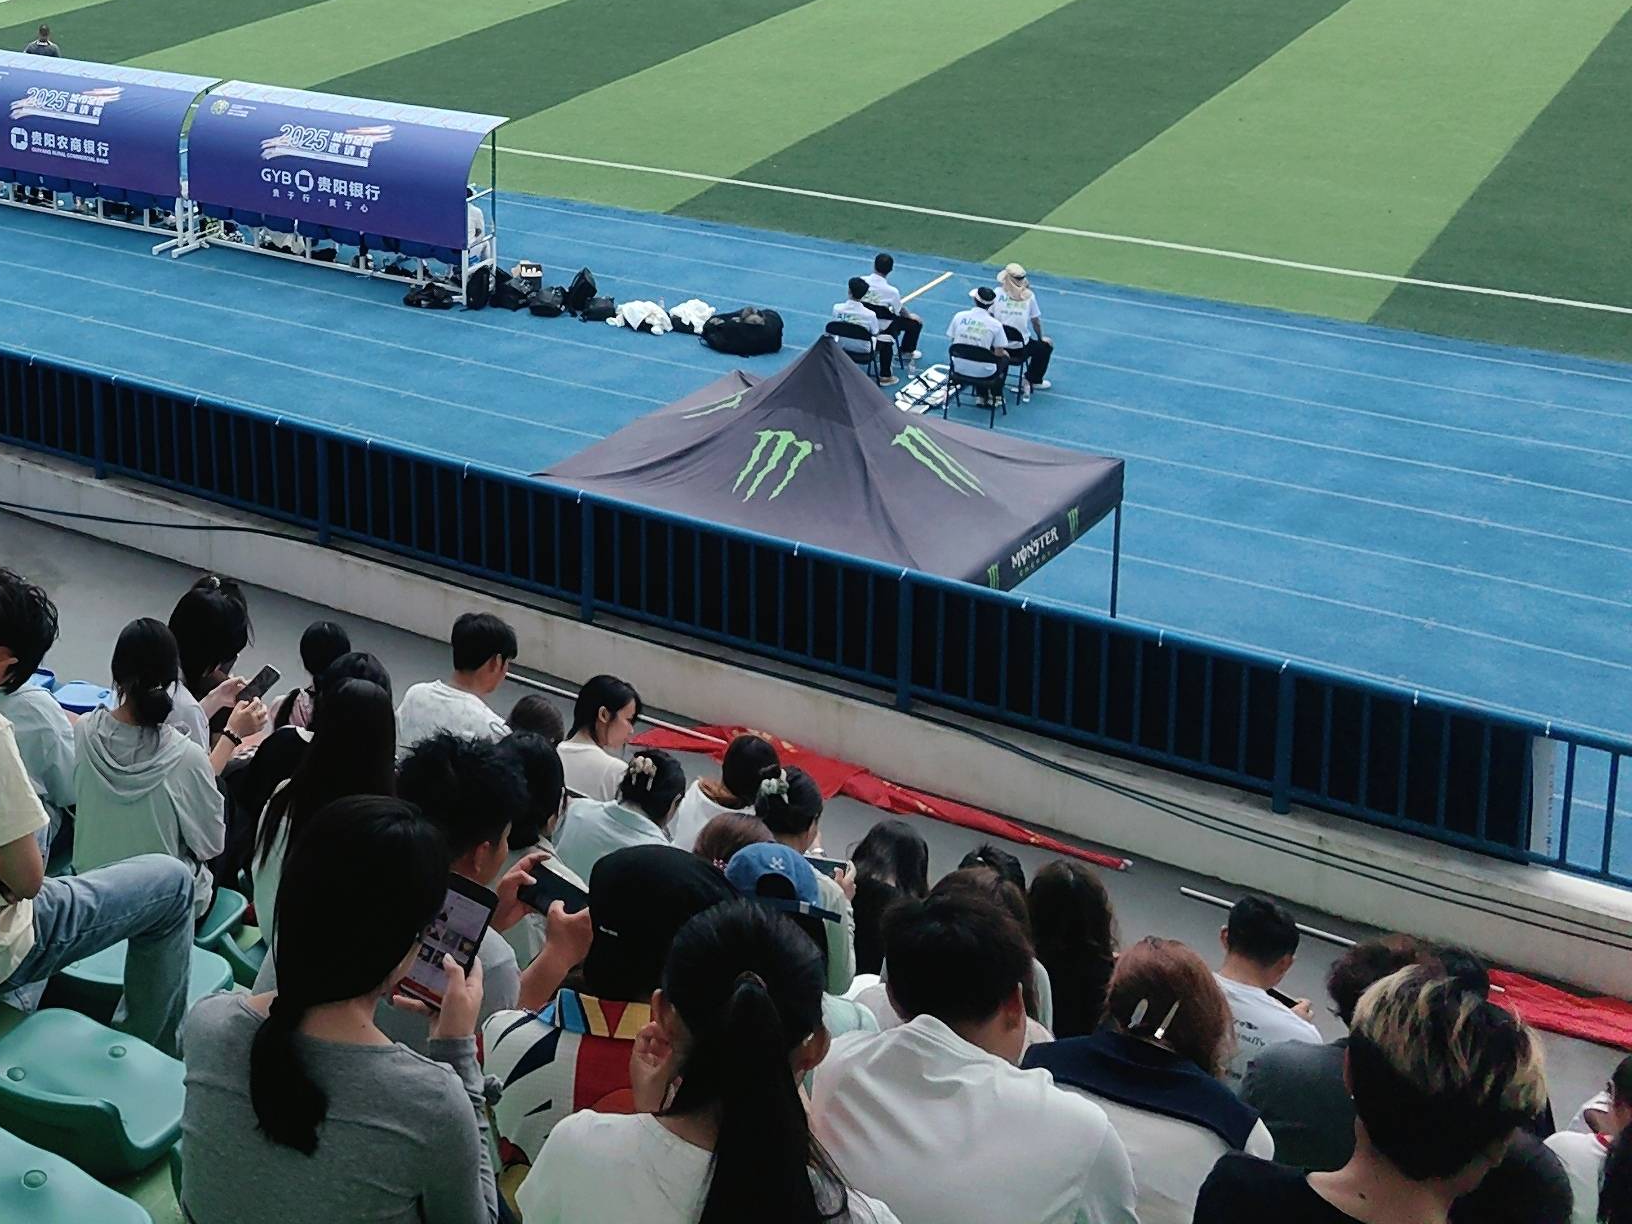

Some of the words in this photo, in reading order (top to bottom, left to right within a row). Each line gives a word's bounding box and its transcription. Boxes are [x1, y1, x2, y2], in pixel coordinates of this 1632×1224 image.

[27, 87, 70, 112] 2025
[31, 130, 110, 157] 贵阳农商银行
[280, 123, 330, 153] 2025
[261, 167, 292, 185] GYB
[317, 175, 381, 201] 贵阳银行
[1011, 526, 1060, 569] MONSTER
